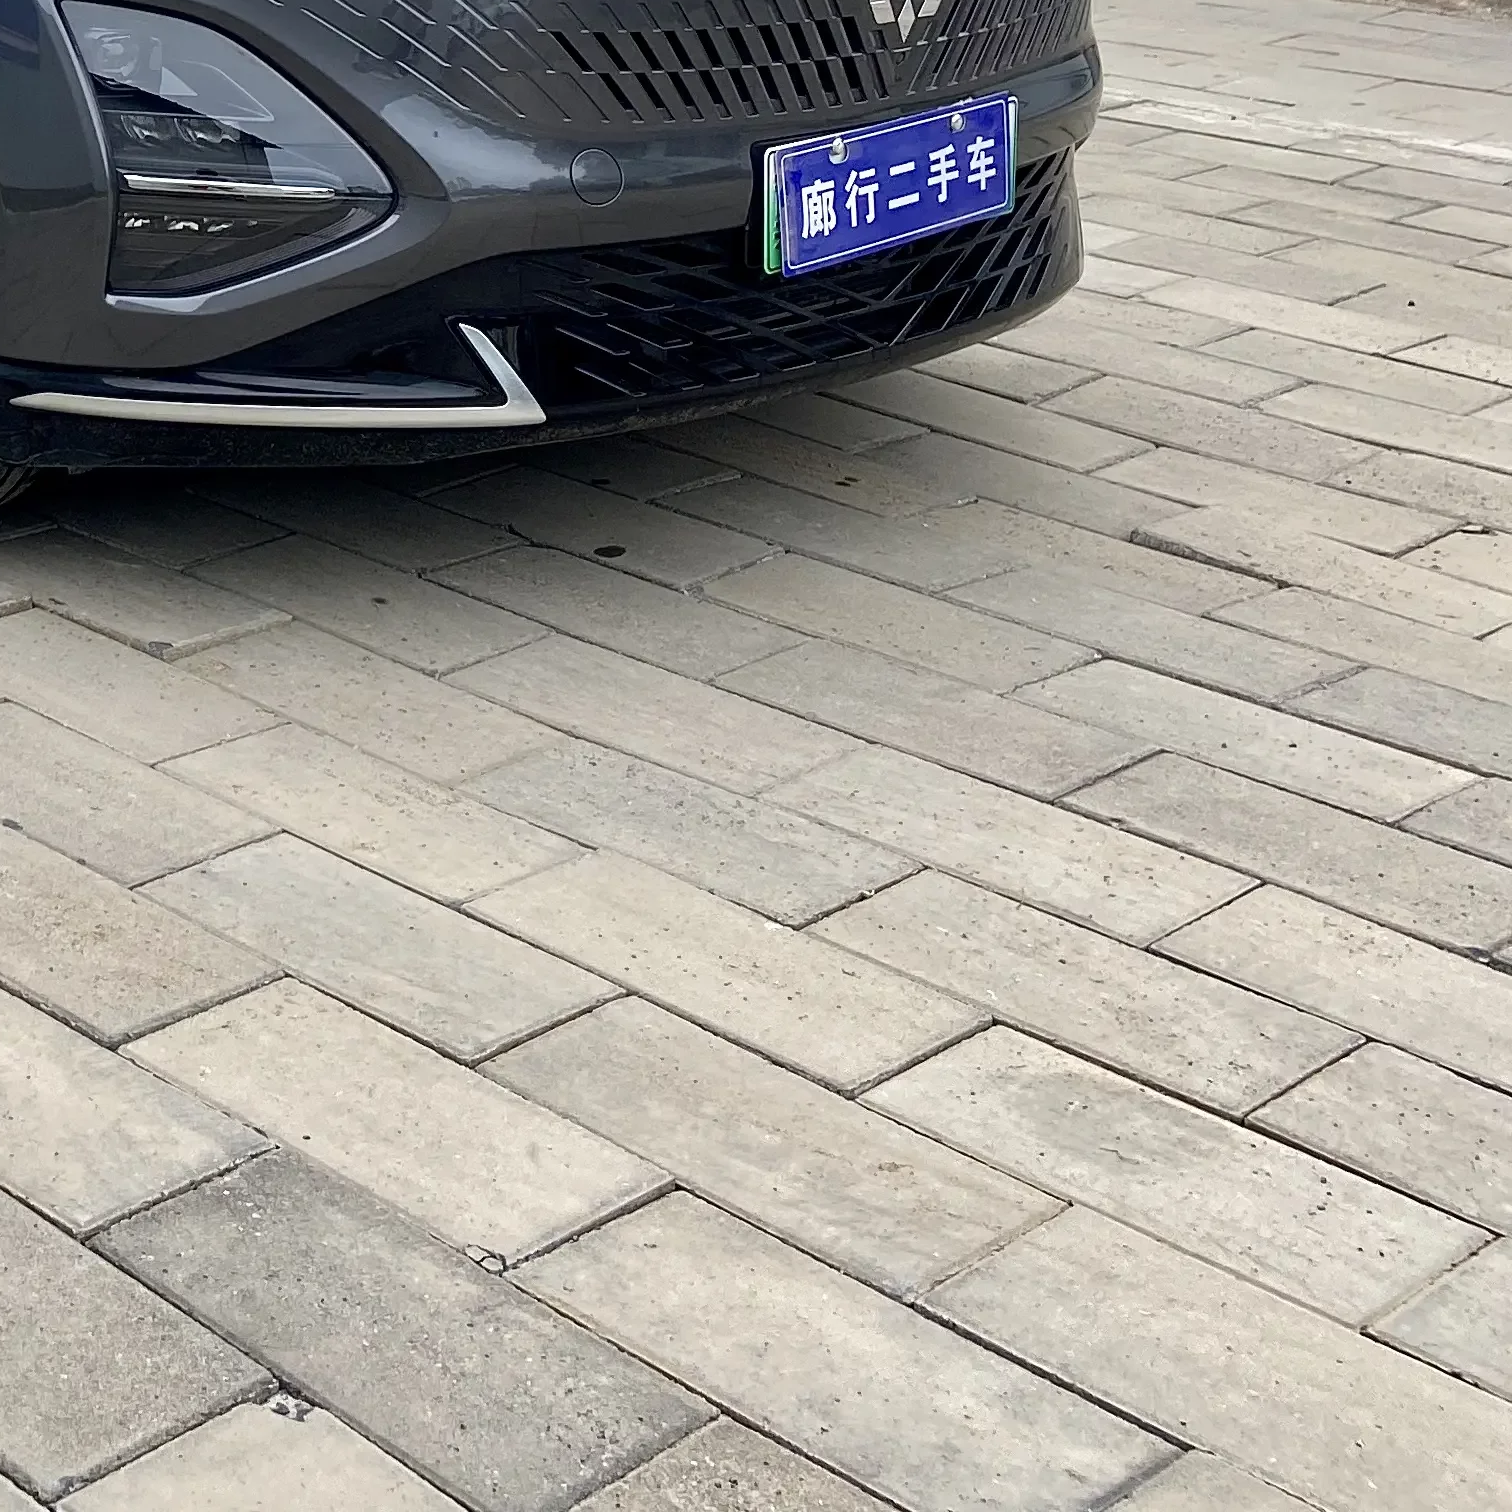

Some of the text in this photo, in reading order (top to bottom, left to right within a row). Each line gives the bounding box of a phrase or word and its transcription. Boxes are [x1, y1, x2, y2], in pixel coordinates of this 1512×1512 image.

[801, 136, 997, 239] 廊行二手车
